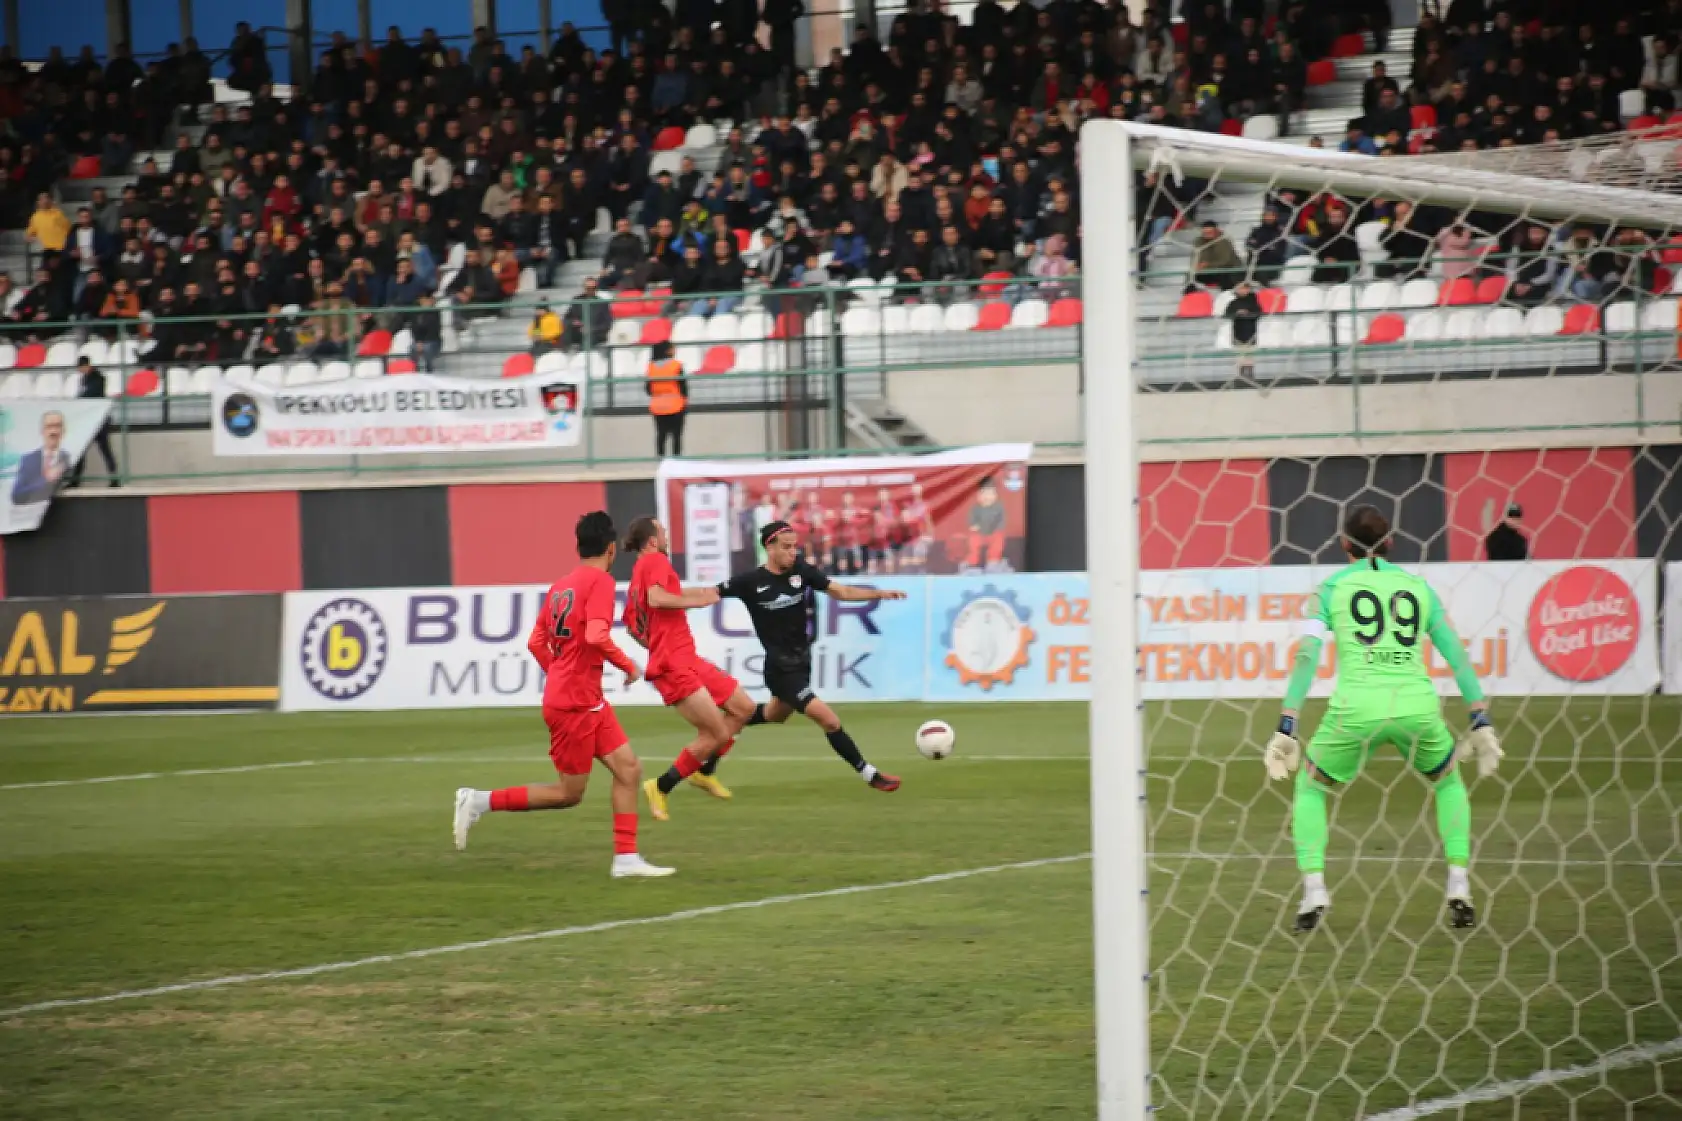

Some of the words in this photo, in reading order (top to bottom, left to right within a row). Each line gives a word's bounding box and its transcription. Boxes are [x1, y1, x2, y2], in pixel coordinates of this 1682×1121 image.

[1145, 588, 1246, 622] YASİN
[1350, 589, 1420, 646] 99
[1539, 628, 1588, 655] Özel
[1592, 623, 1633, 646] Lise
